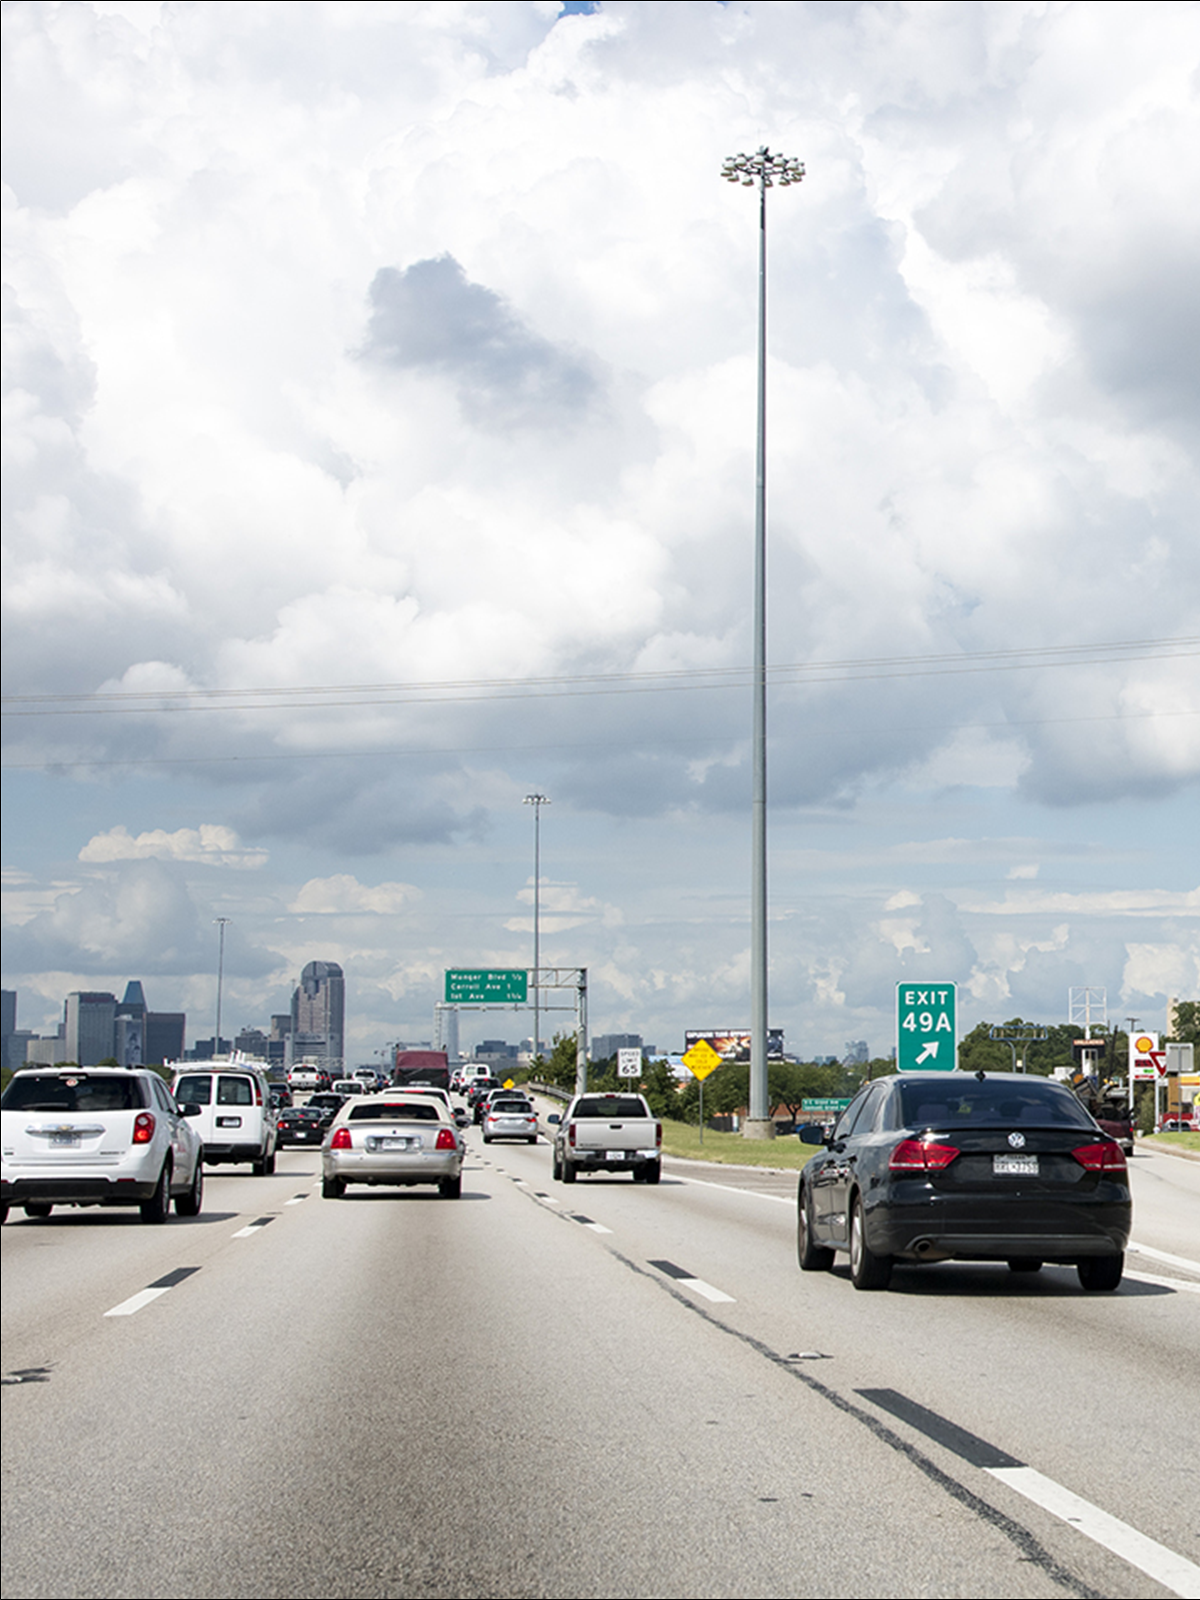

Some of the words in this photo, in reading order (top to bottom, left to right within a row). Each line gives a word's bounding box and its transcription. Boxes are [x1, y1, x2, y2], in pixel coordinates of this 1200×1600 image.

[905, 991, 948, 1005] EXIT
[902, 1012, 952, 1032] 49A
[622, 1064, 638, 1074] 65
